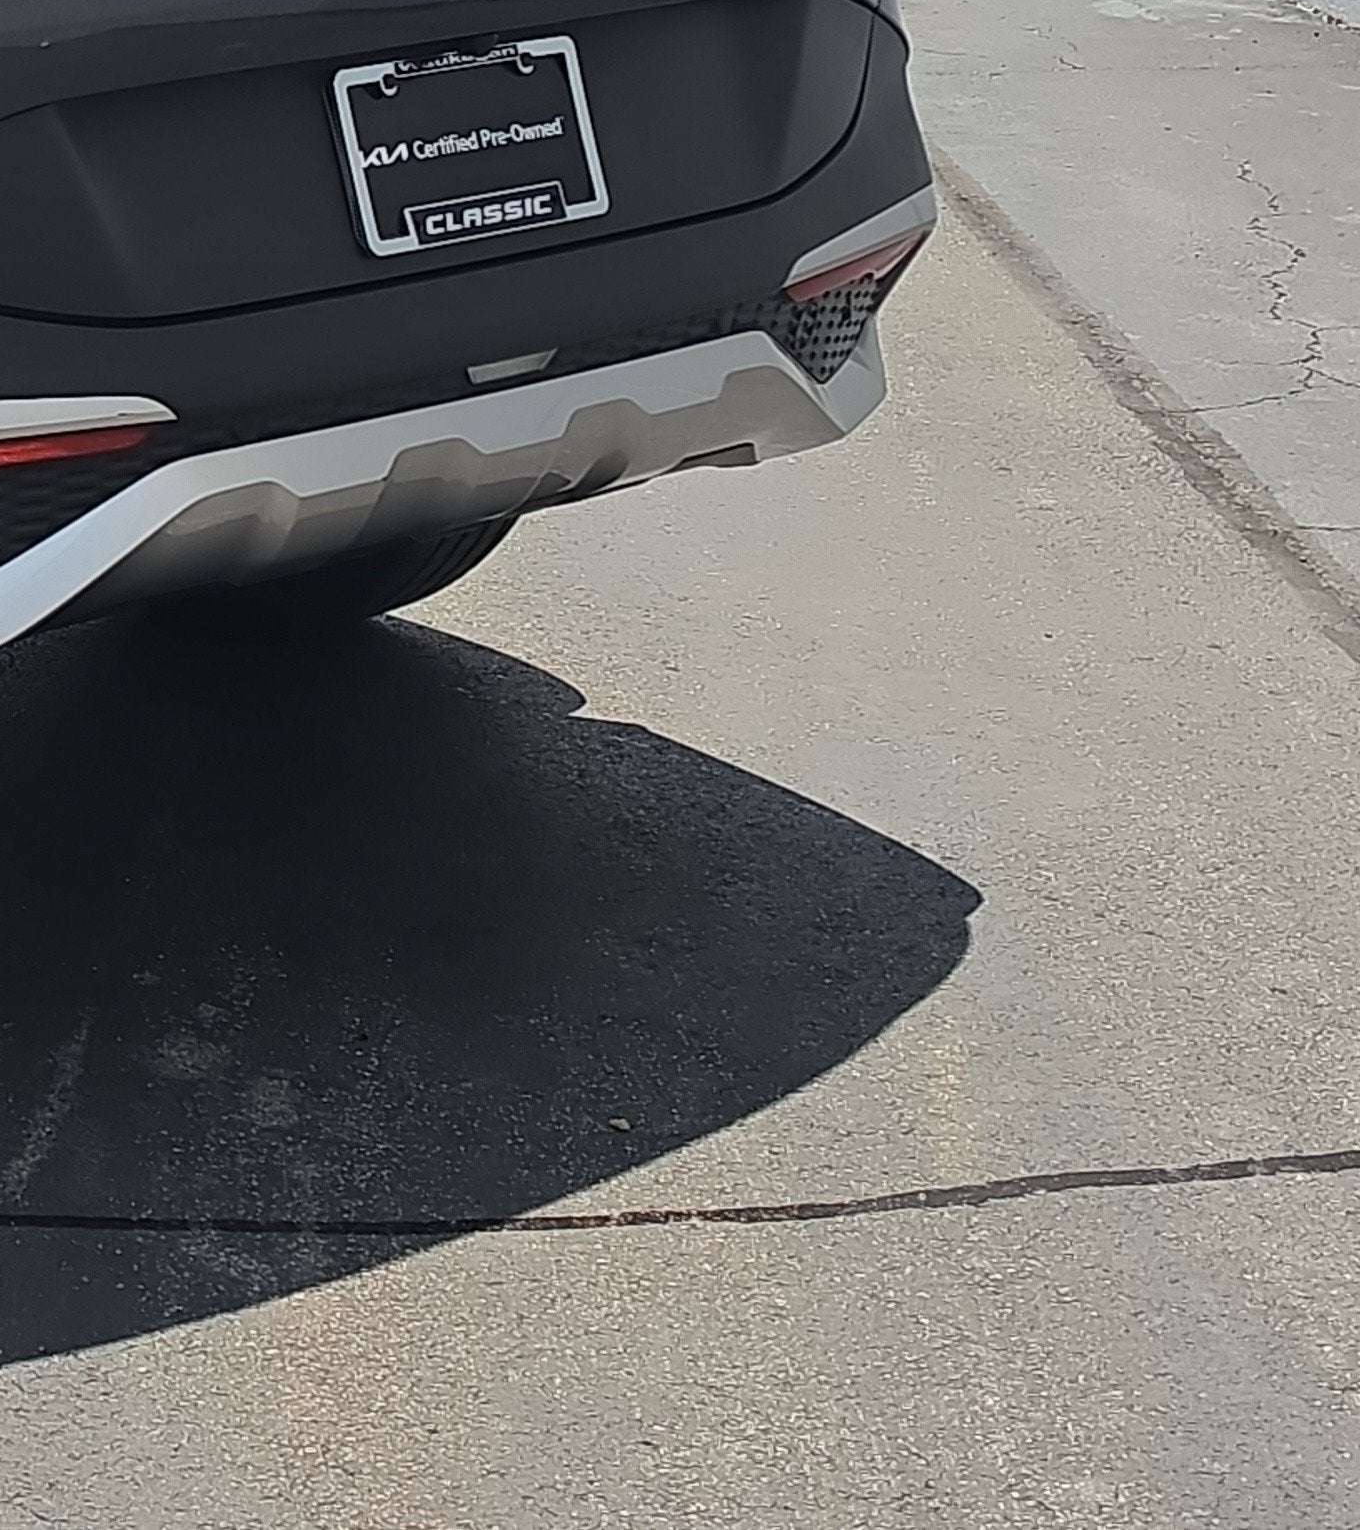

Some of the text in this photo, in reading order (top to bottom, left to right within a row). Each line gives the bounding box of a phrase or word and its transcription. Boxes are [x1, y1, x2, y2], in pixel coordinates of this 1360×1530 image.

[413, 131, 479, 160] Certified
[480, 117, 562, 149] Pre-Owned
[426, 194, 553, 235] CLASSIC
